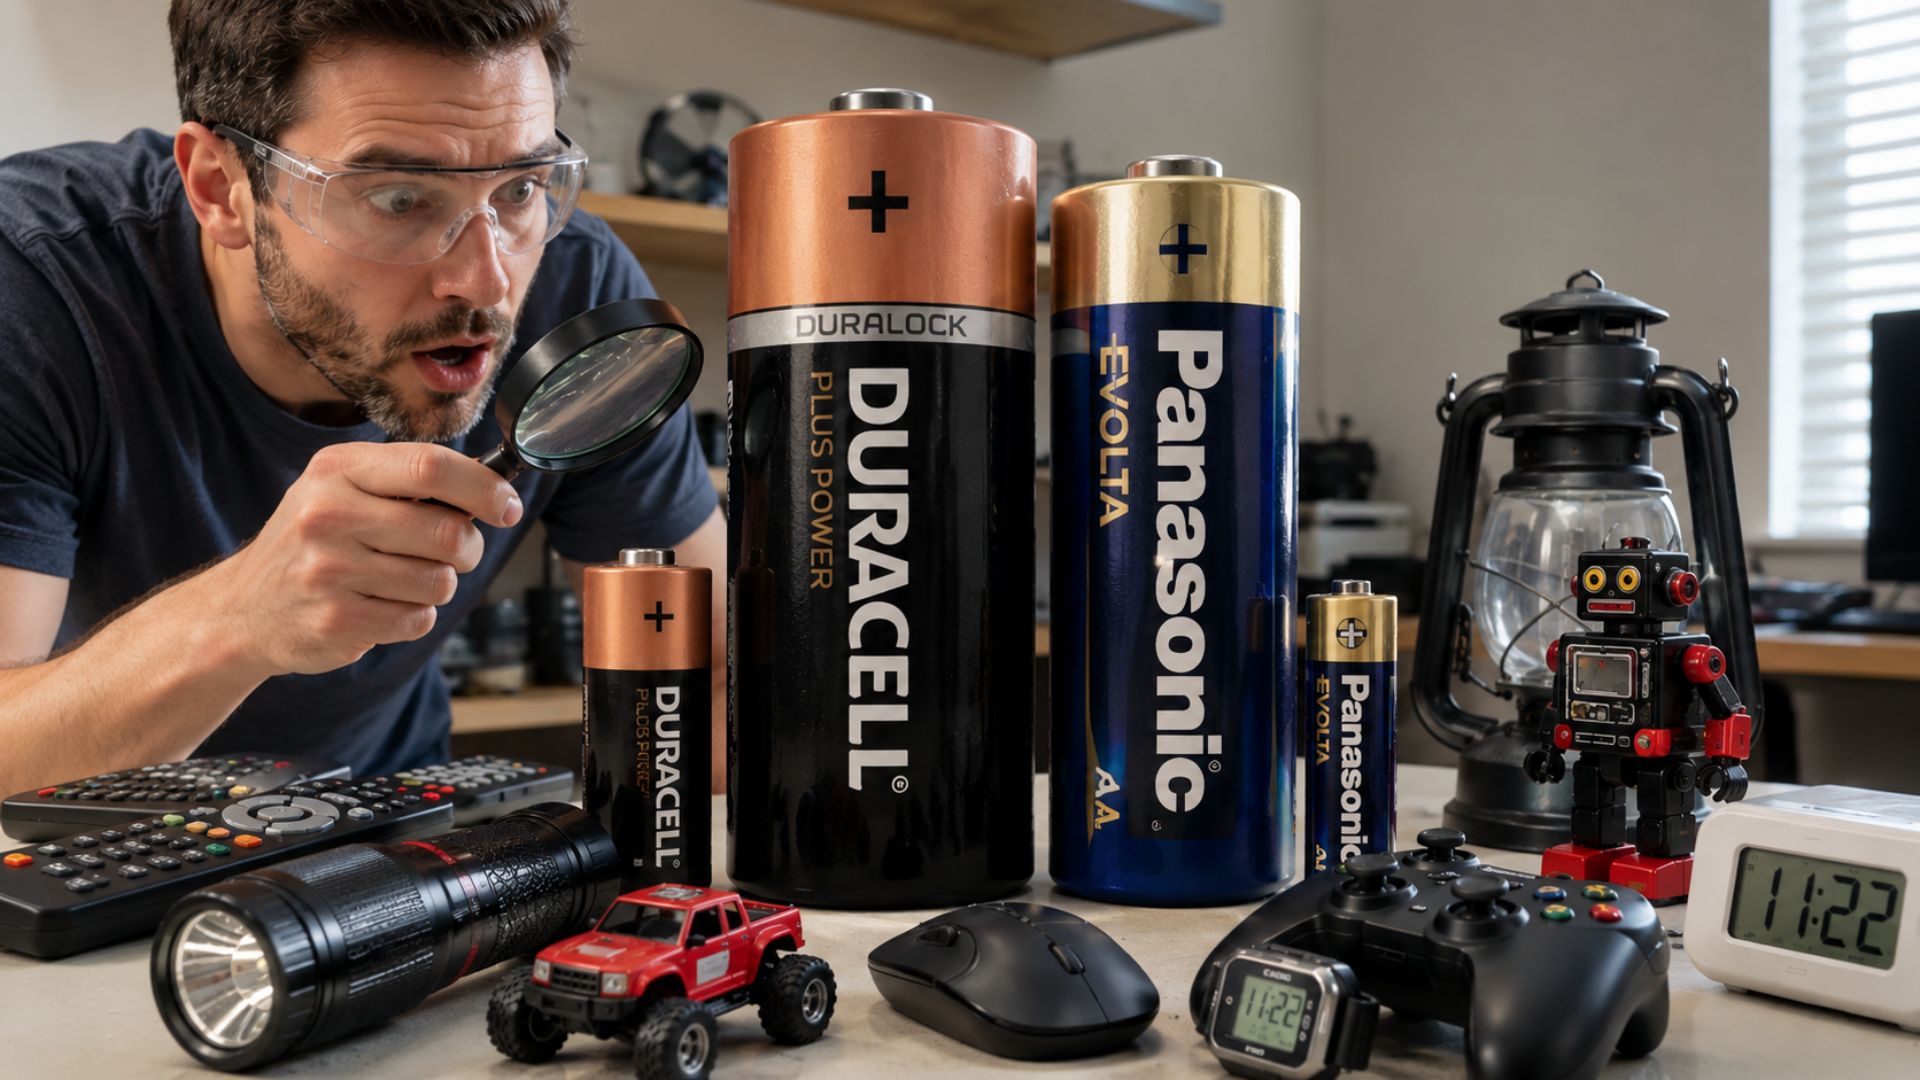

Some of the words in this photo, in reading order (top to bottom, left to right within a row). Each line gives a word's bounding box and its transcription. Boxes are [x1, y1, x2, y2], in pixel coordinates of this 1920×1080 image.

[796, 313, 967, 337] DURALOCK
[811, 371, 833, 458] PLUS
[1100, 333, 1129, 528] EVOLTA
[811, 469, 833, 589] POWER
[848, 368, 909, 791] DURACELL
[1155, 330, 1223, 813] Panasonic
[1316, 673, 1330, 765] EVOLTA
[655, 686, 680, 868] DURACELL
[1764, 866, 1898, 956] 11:22
[1246, 989, 1302, 1028] 11:22
